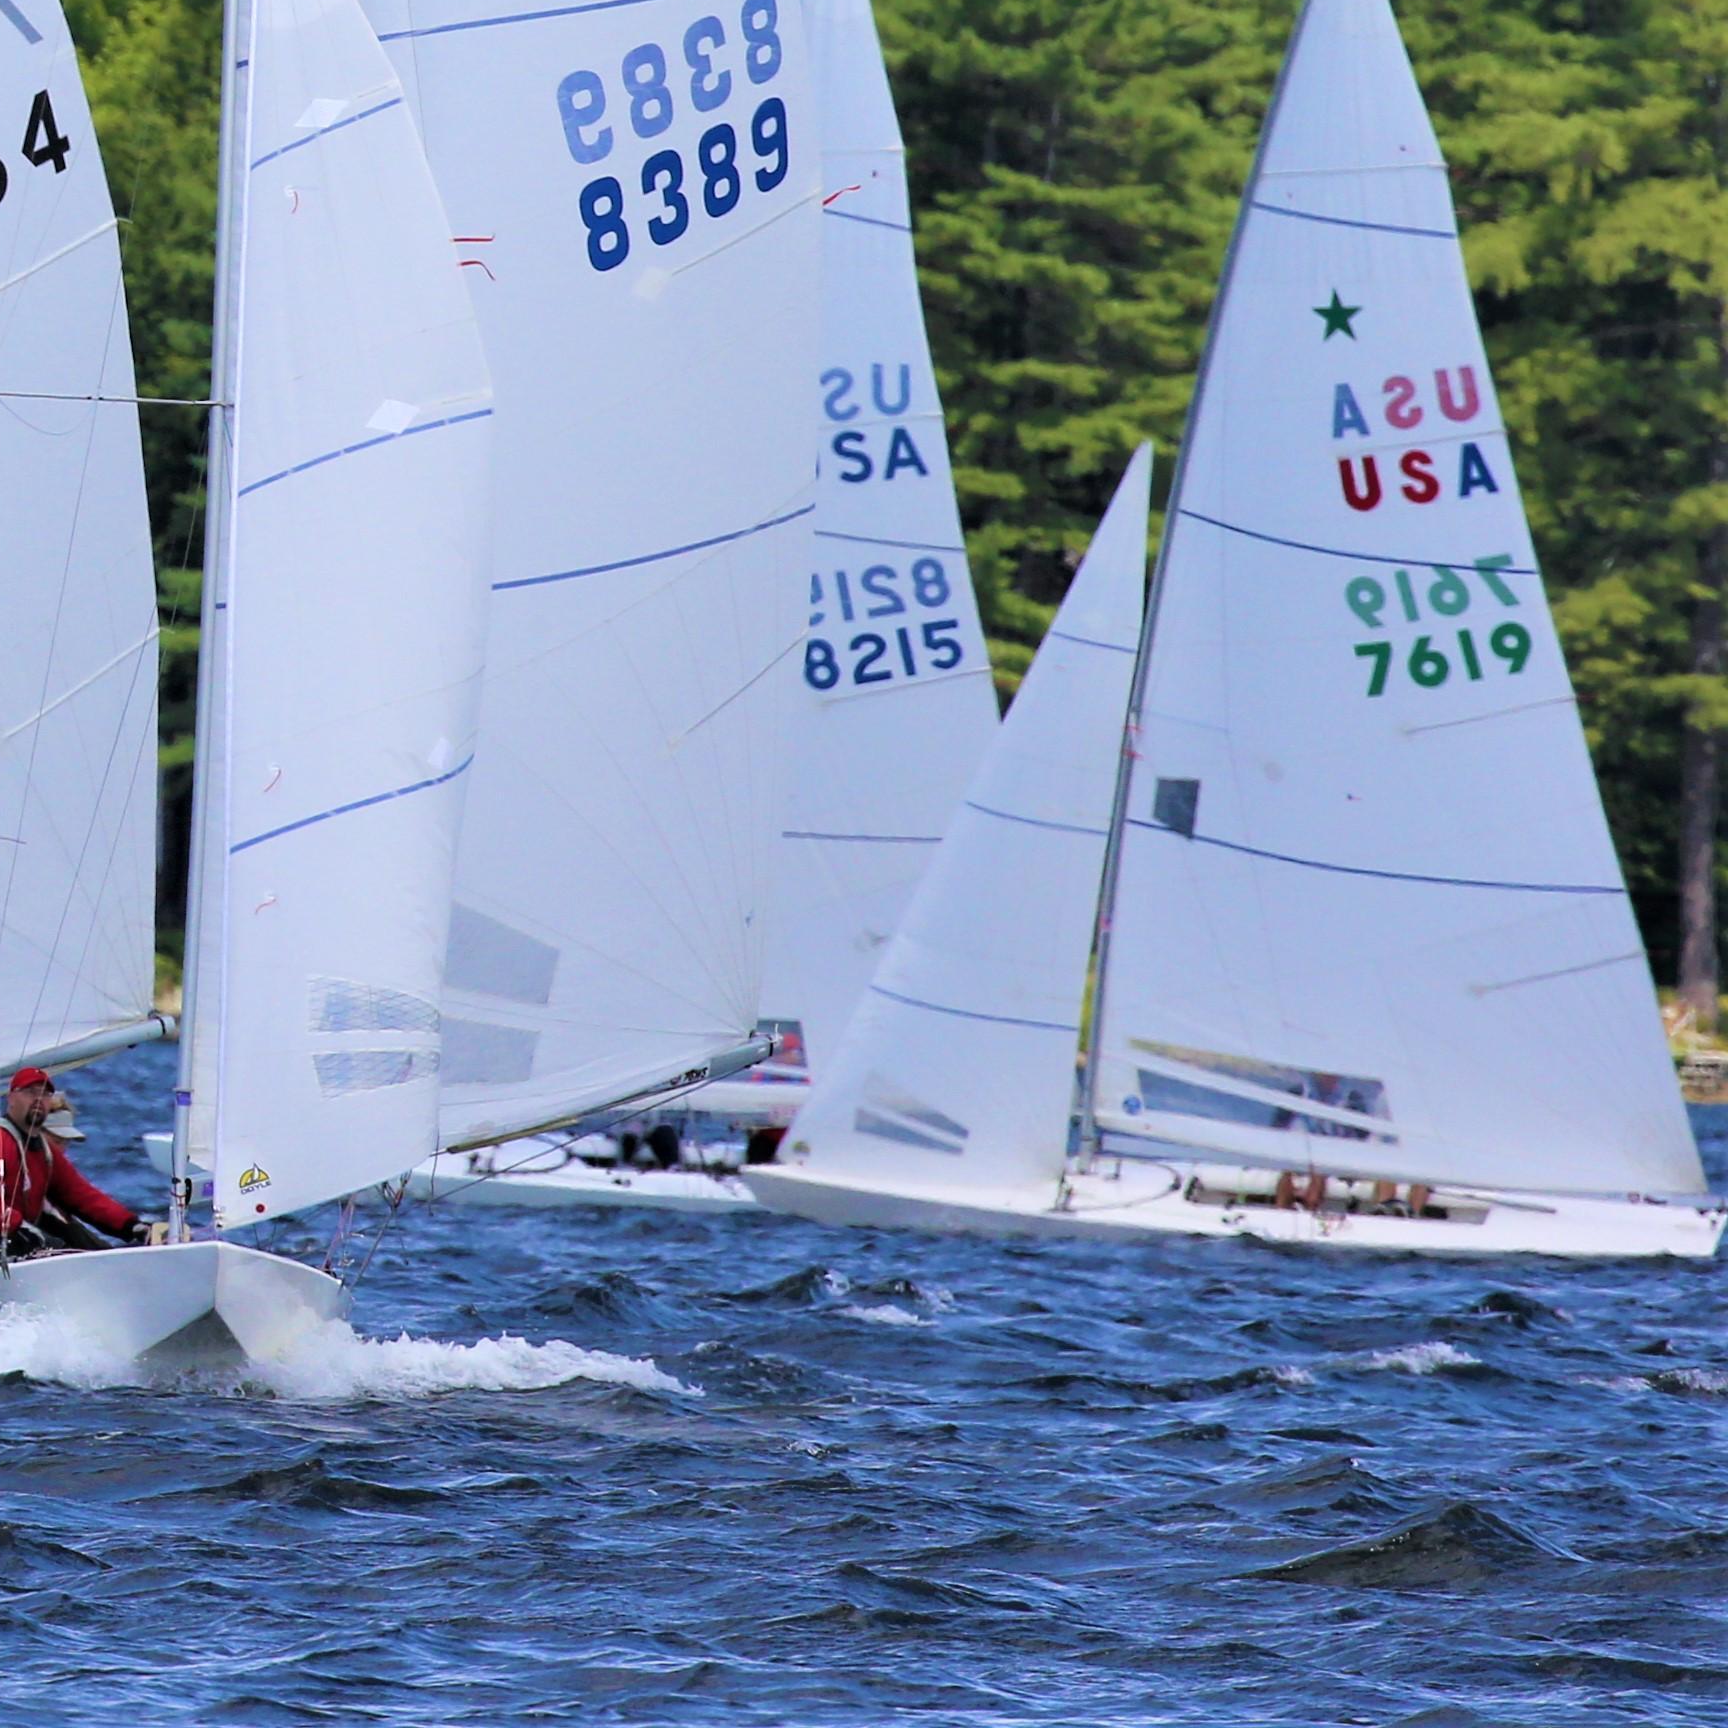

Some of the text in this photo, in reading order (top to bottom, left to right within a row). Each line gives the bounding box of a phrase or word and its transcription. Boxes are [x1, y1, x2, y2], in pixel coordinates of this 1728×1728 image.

[579, 97, 790, 272] 8389
[815, 427, 929, 484] SA
[1338, 442, 1499, 512] USA
[804, 619, 963, 690] 8215
[1353, 622, 1532, 697] 7619
